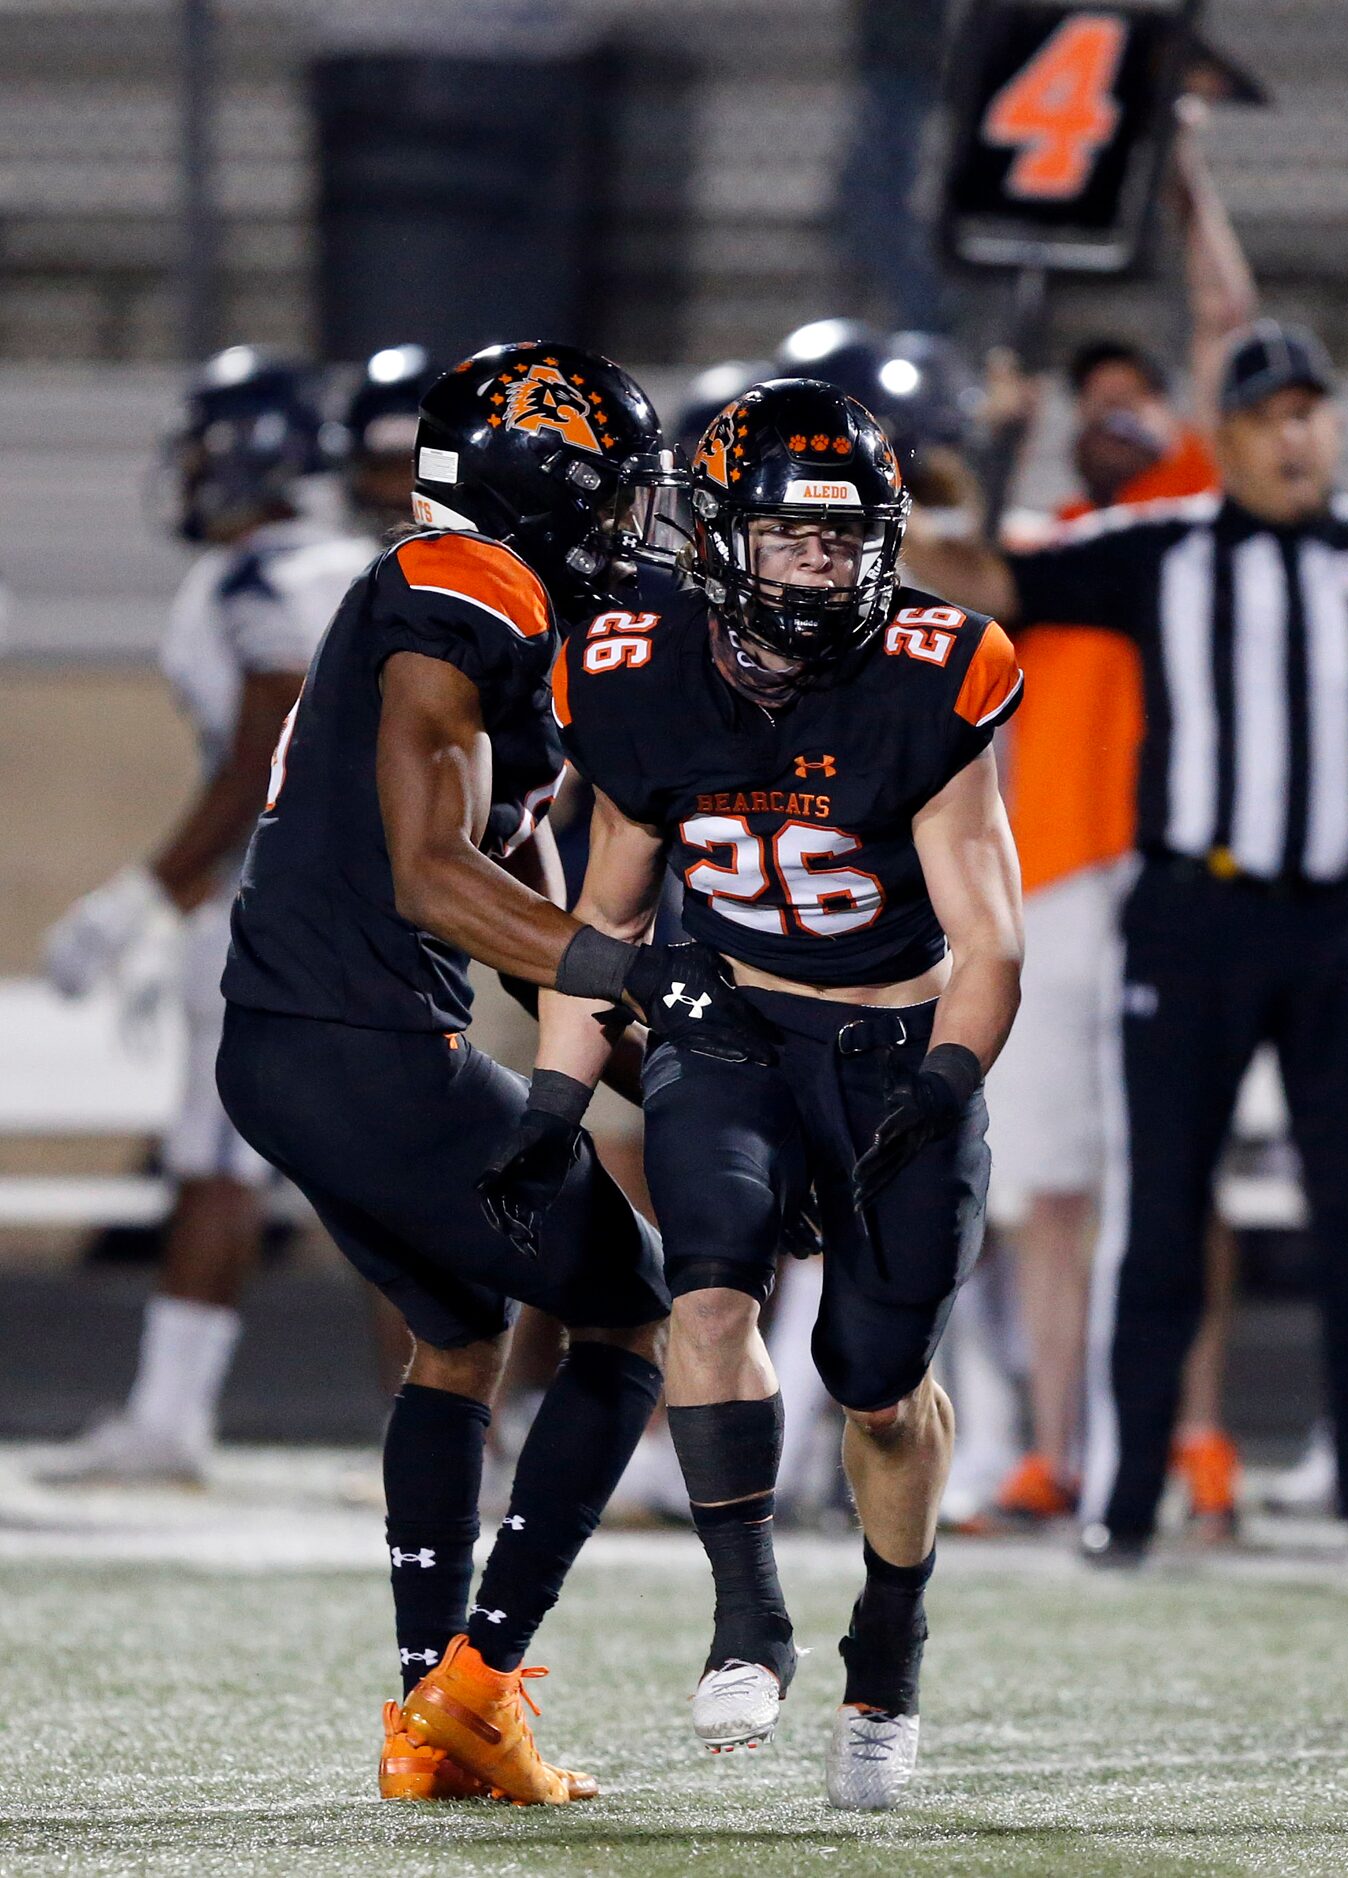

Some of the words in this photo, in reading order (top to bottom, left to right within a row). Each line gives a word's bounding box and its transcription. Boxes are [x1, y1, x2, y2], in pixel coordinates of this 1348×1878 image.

[980, 12, 1129, 200] 4
[803, 485, 848, 500] ALEDO
[583, 609, 662, 675] 26
[883, 605, 967, 668] 26
[696, 791, 831, 818] BEARCATS
[679, 811, 887, 937] 26
